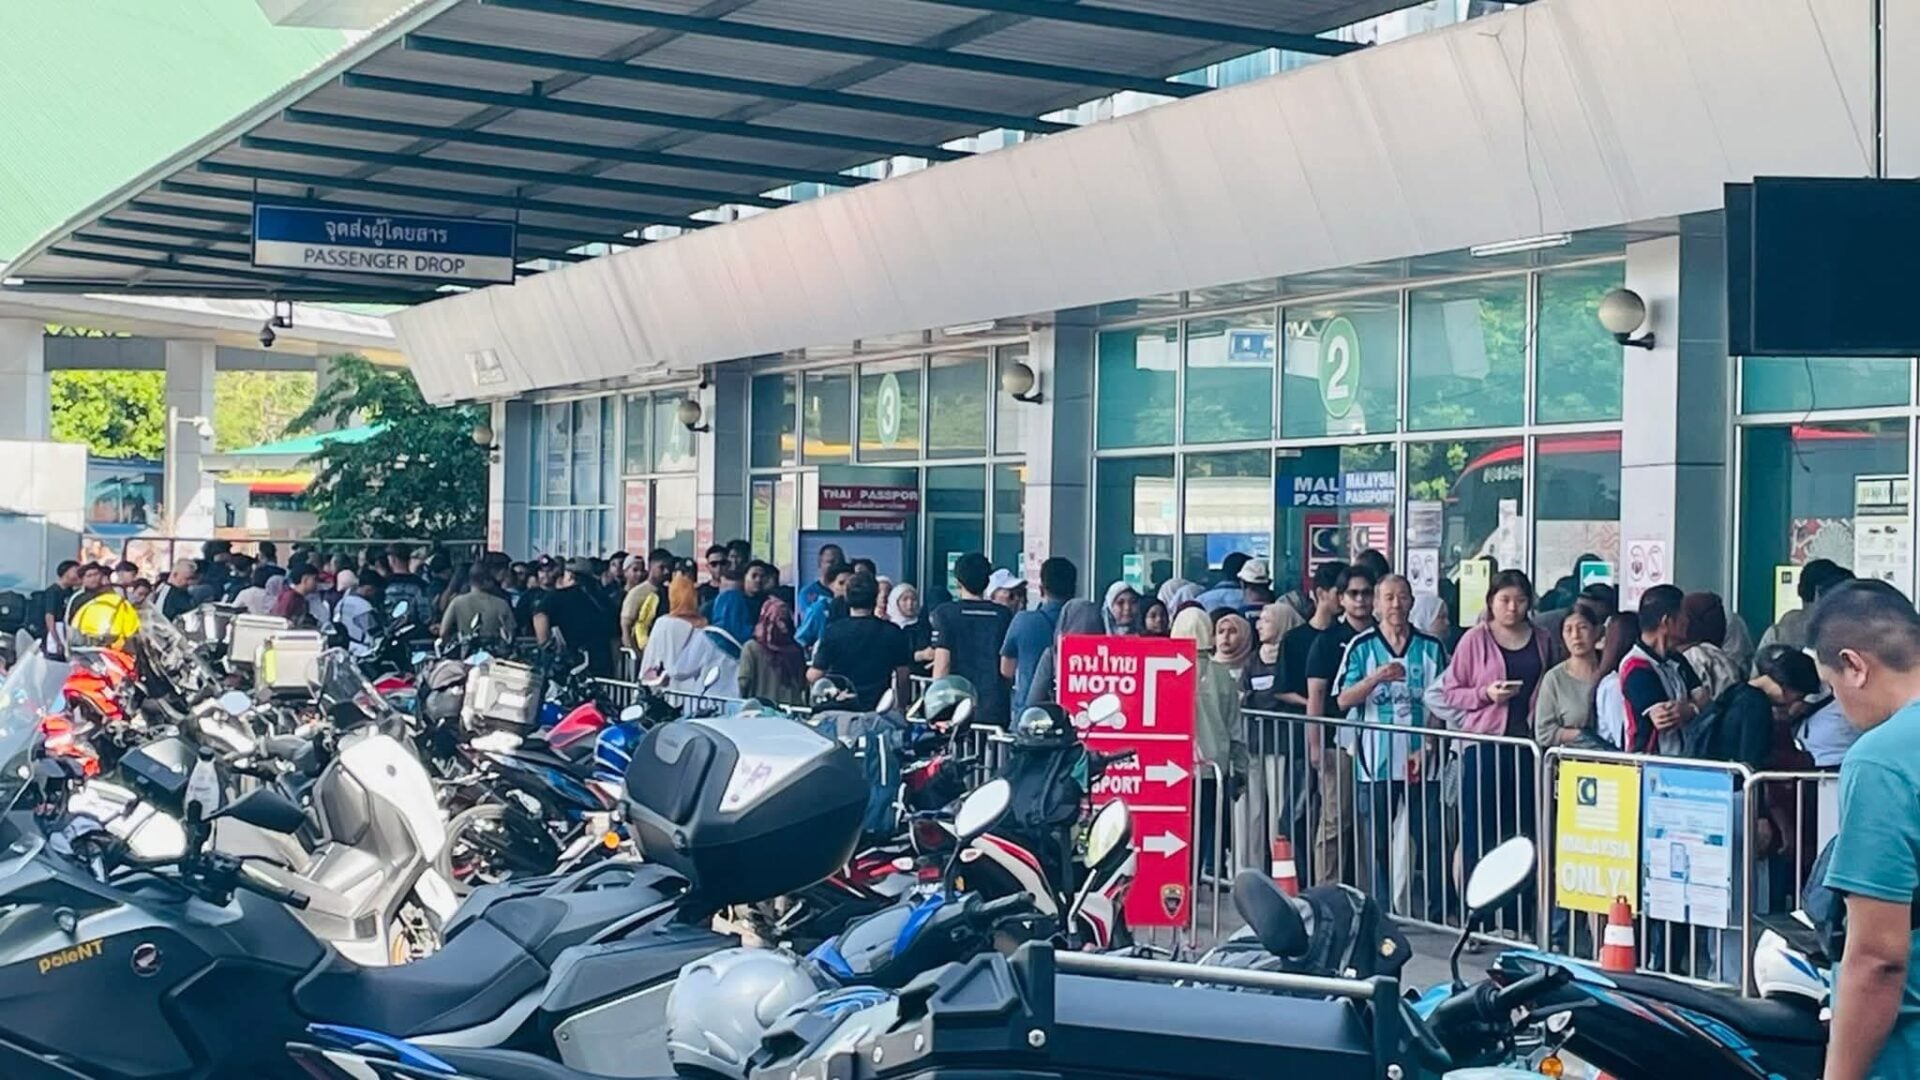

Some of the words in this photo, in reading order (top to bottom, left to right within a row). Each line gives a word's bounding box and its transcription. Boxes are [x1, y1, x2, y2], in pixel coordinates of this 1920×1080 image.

[325, 218, 448, 246] จุดส่งผู้โดยสาร
[303, 248, 409, 270] PASSENGER
[415, 256, 466, 274] DROP
[1326, 335, 1350, 400] 2
[882, 387, 895, 435] 3
[1345, 471, 1395, 489] MALAYSIA
[822, 489, 852, 499] THAI
[1345, 489, 1395, 504] PASSPORT
[1068, 645, 1137, 674] คนไทย
[1068, 674, 1137, 695] MOTO
[1561, 833, 1631, 859] MALAYSIA
[1560, 862, 1631, 898] ONLY!
